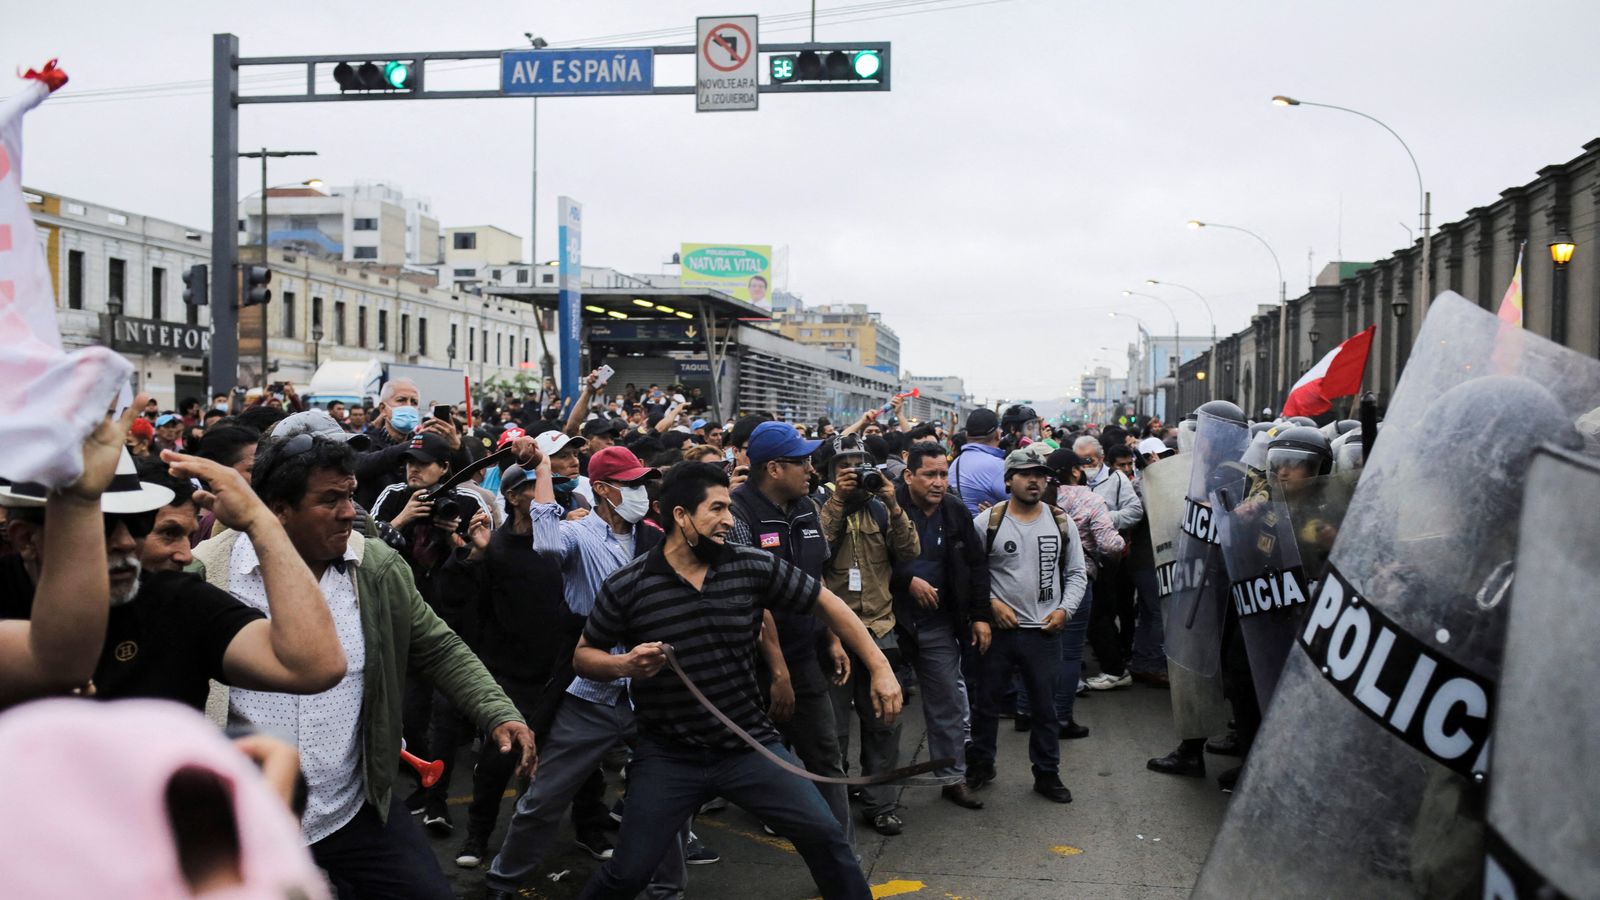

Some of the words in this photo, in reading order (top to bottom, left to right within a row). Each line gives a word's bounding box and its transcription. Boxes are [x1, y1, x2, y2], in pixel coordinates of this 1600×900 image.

[511, 60, 544, 84] AV.
[552, 54, 642, 83] ESPAÑA
[700, 94, 710, 105] LA
[711, 92, 755, 104] IZQUIERDA
[689, 256, 732, 272] NATURA
[734, 258, 765, 273] VITAL
[1039, 536, 1058, 590] JORDAN
[1038, 587, 1054, 604] AIR
